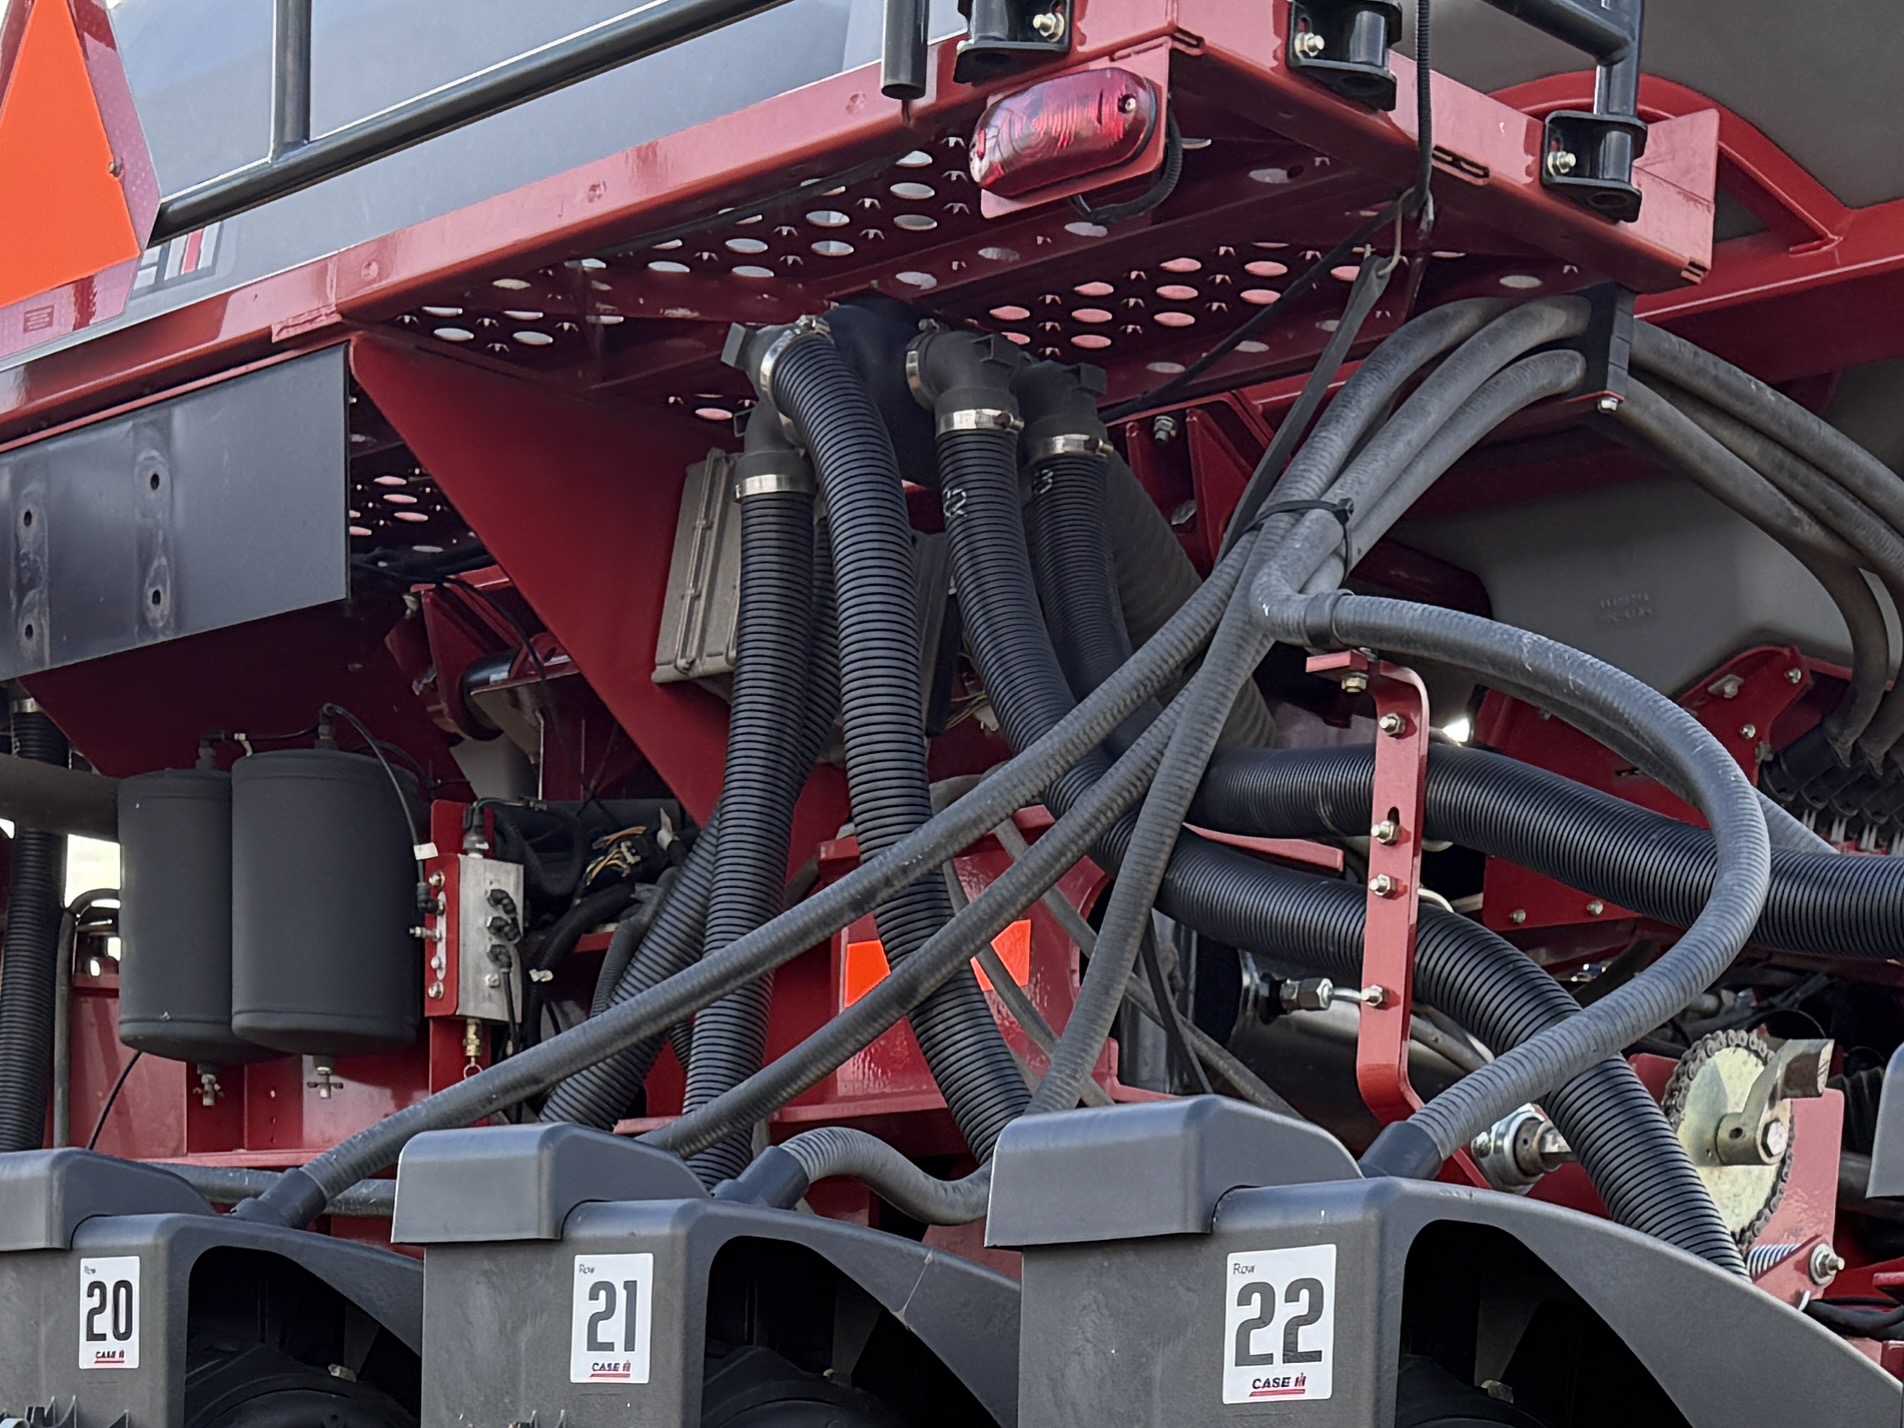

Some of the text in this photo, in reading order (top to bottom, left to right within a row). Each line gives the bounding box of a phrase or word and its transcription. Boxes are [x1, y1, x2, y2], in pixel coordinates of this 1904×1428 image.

[1233, 1263, 1255, 1275] Row
[86, 1279, 133, 1342] 20
[586, 1280, 638, 1352] 21
[1235, 1277, 1324, 1367] 22
[591, 1362, 620, 1372] CASE
[1252, 1376, 1292, 1389] CASE
